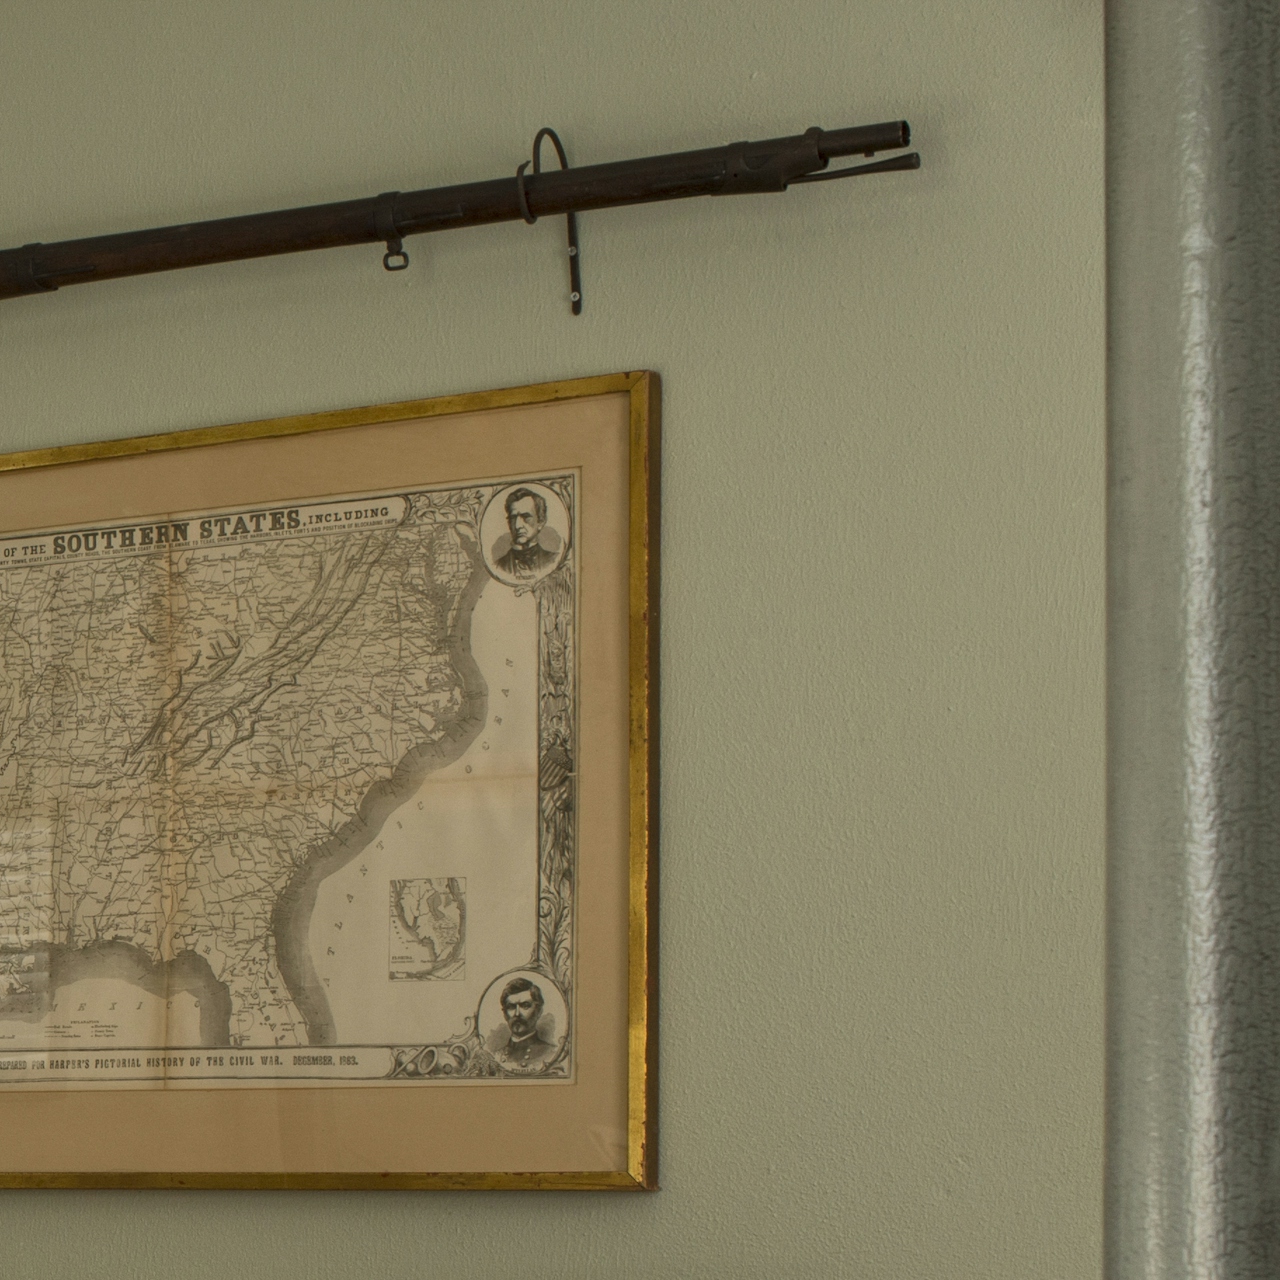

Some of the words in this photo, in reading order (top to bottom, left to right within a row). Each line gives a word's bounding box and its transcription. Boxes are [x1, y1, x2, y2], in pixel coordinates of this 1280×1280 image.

[4, 547, 17, 557] OF
[22, 545, 46, 556] THE
[53, 522, 190, 554] SOUTHERN
[308, 507, 389, 524] INCLUDING
[31, 1060, 45, 1069] FOR
[49, 1059, 90, 1069] HARPER'S
[95, 1058, 141, 1069] PICTORIAL
[146, 1057, 184, 1067] HISTORY
[190, 1056, 200, 1066] OF
[206, 1056, 224, 1066] THE
[229, 1056, 254, 1066] CIVIL
[260, 1056, 283, 1066] WAR.
